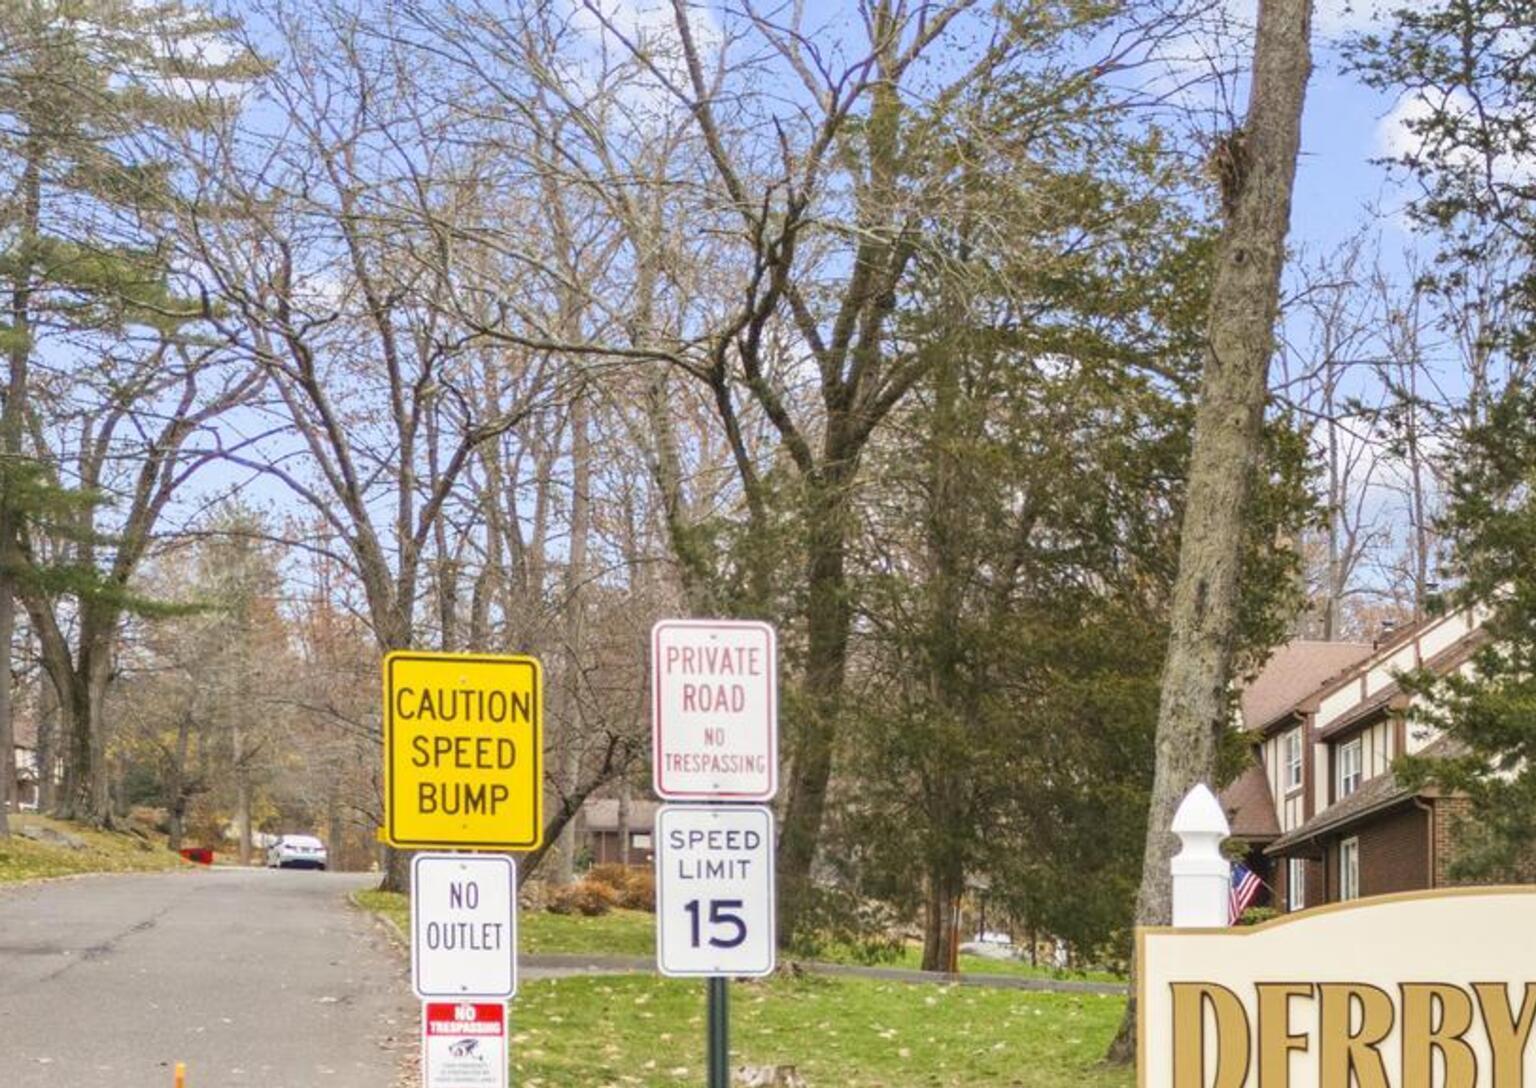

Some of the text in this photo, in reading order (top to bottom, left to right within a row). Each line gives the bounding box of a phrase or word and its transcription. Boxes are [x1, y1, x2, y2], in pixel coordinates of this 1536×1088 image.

[666, 646, 760, 675] PRIVATE
[396, 687, 531, 724] CAUTION
[682, 684, 745, 713] ROAD
[703, 728, 725, 747] NO
[411, 736, 516, 770] SPEED
[665, 753, 766, 774] TRESPASSING
[417, 782, 510, 816] BUMP
[670, 831, 760, 851] SPEED
[678, 860, 751, 881] LIMIT
[449, 881, 479, 910] NO
[426, 921, 503, 951] OUTLET
[684, 900, 747, 949] 15
[454, 1005, 476, 1021] NO
